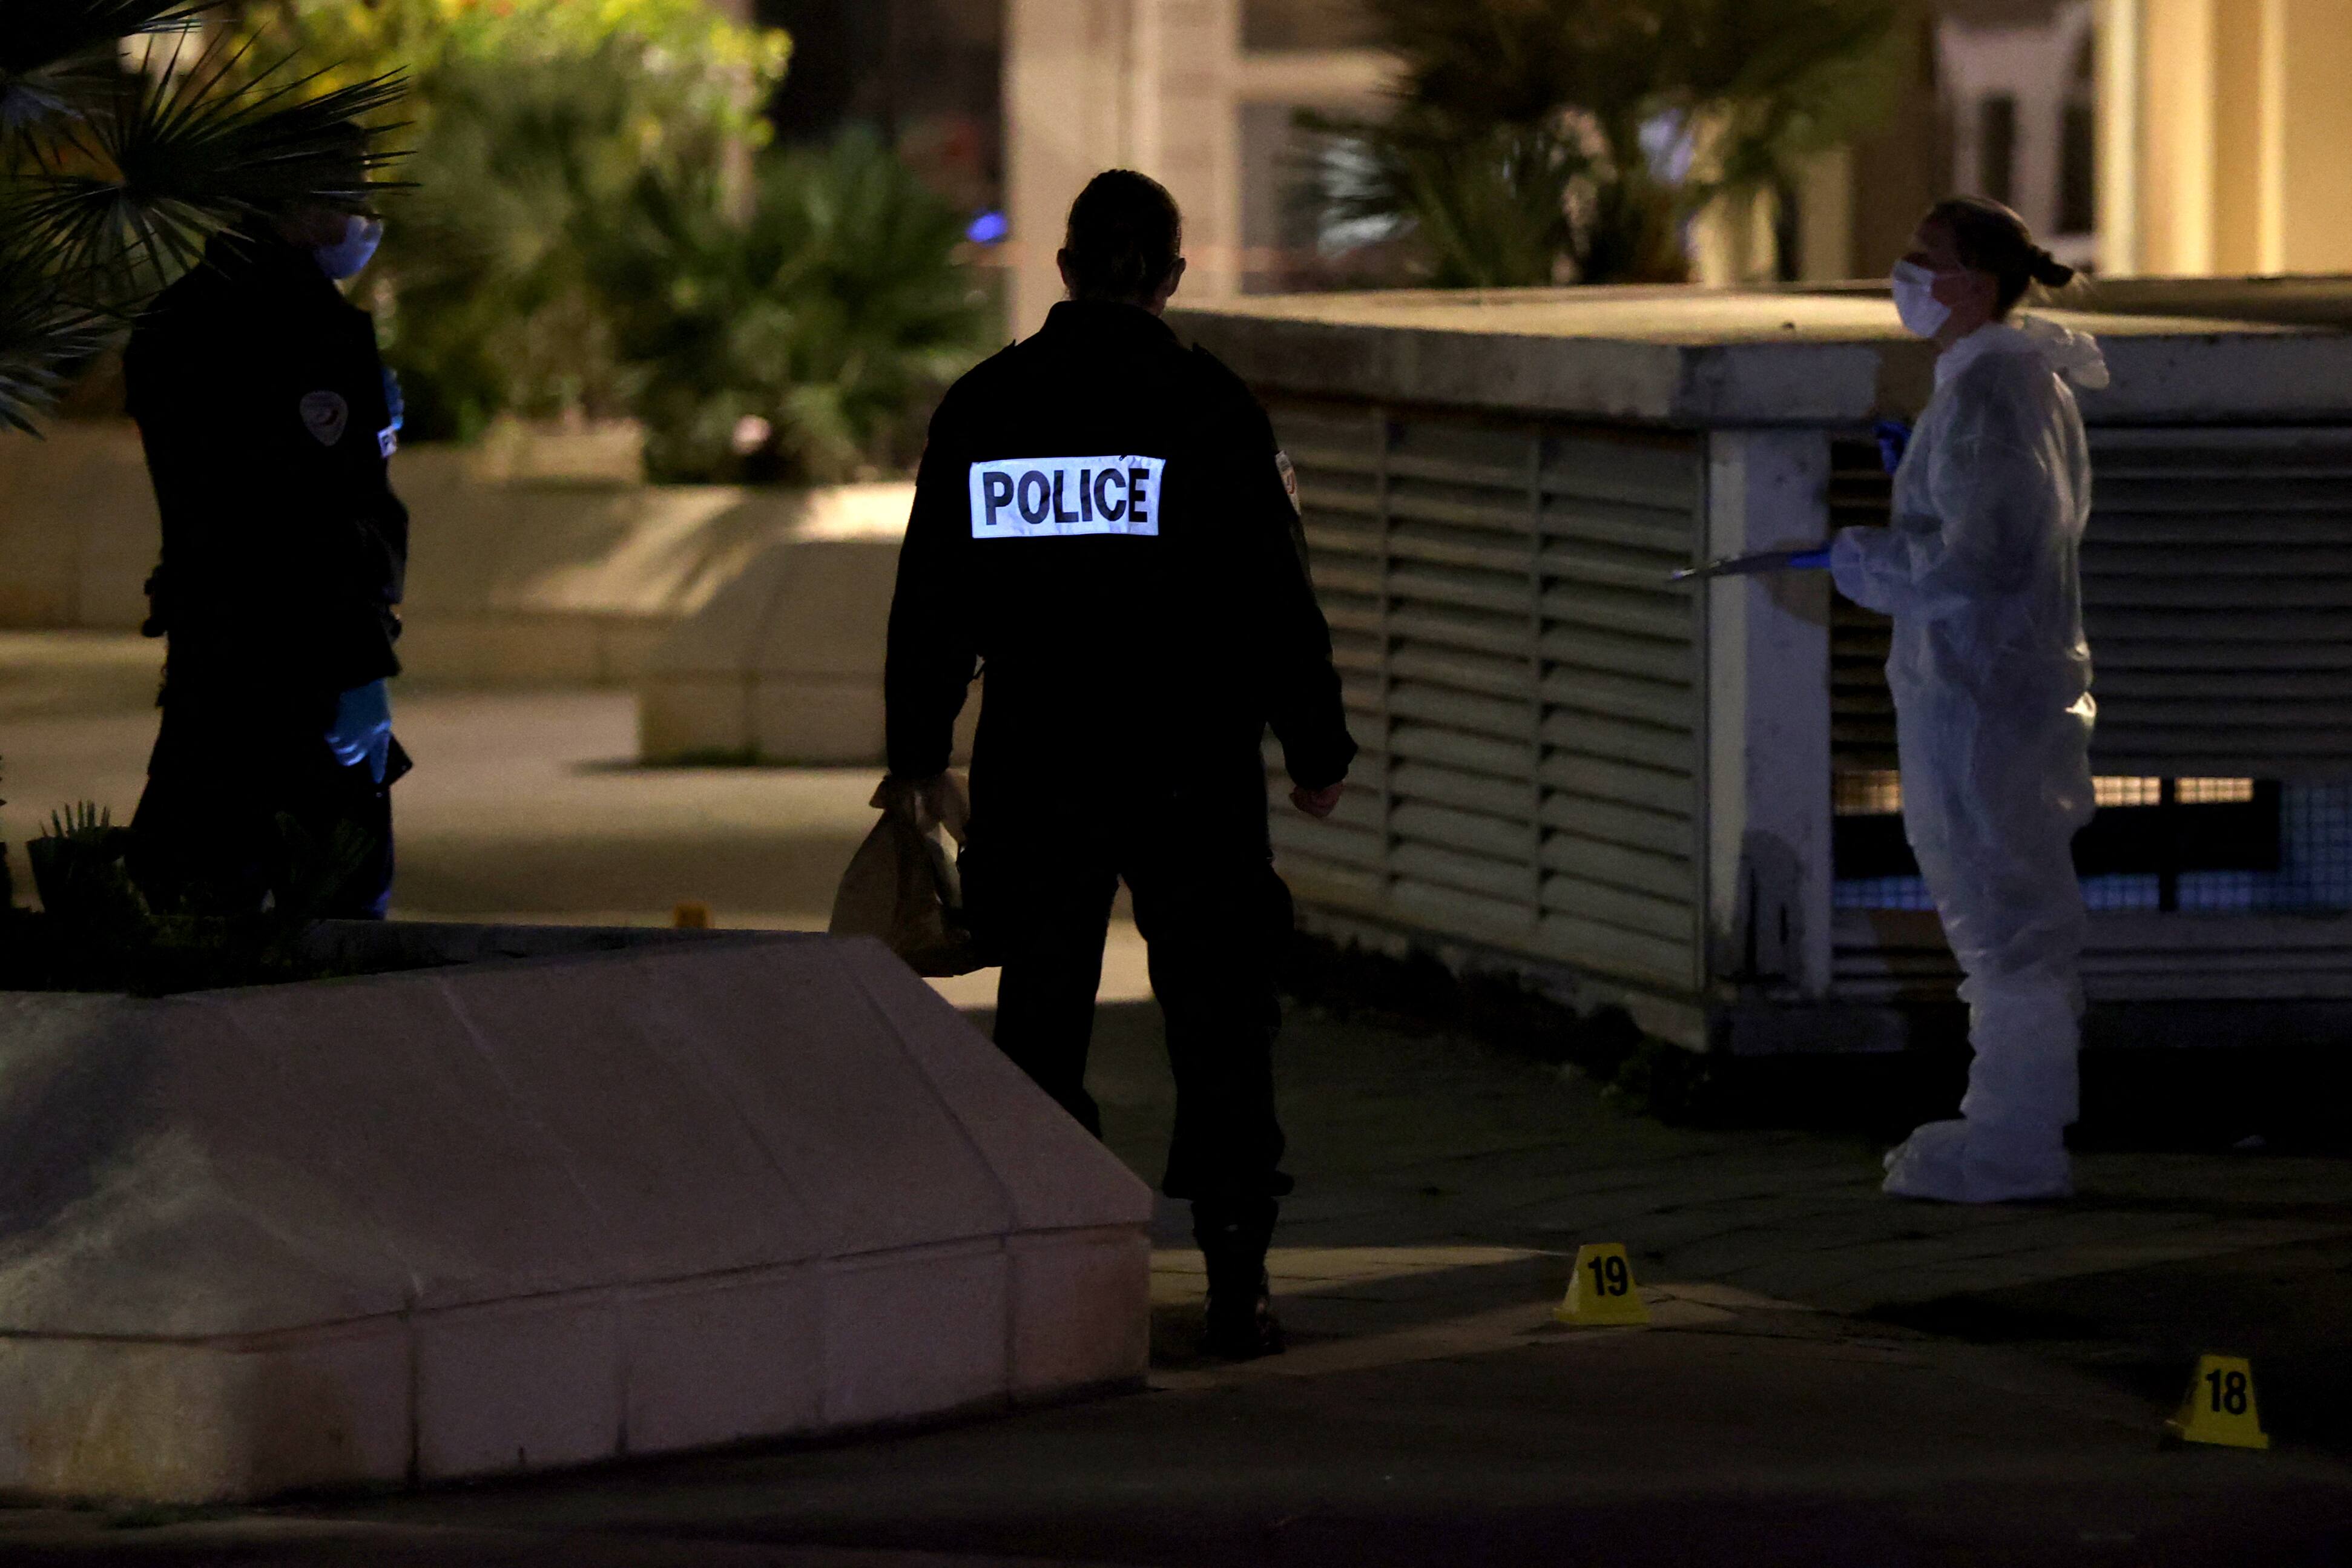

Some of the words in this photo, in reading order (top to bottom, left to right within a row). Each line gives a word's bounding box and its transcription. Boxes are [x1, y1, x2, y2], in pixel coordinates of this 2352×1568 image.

[983, 468, 1150, 525] POLICE
[1588, 1256, 1628, 1296] 19
[2206, 1369, 2247, 1415] 18
